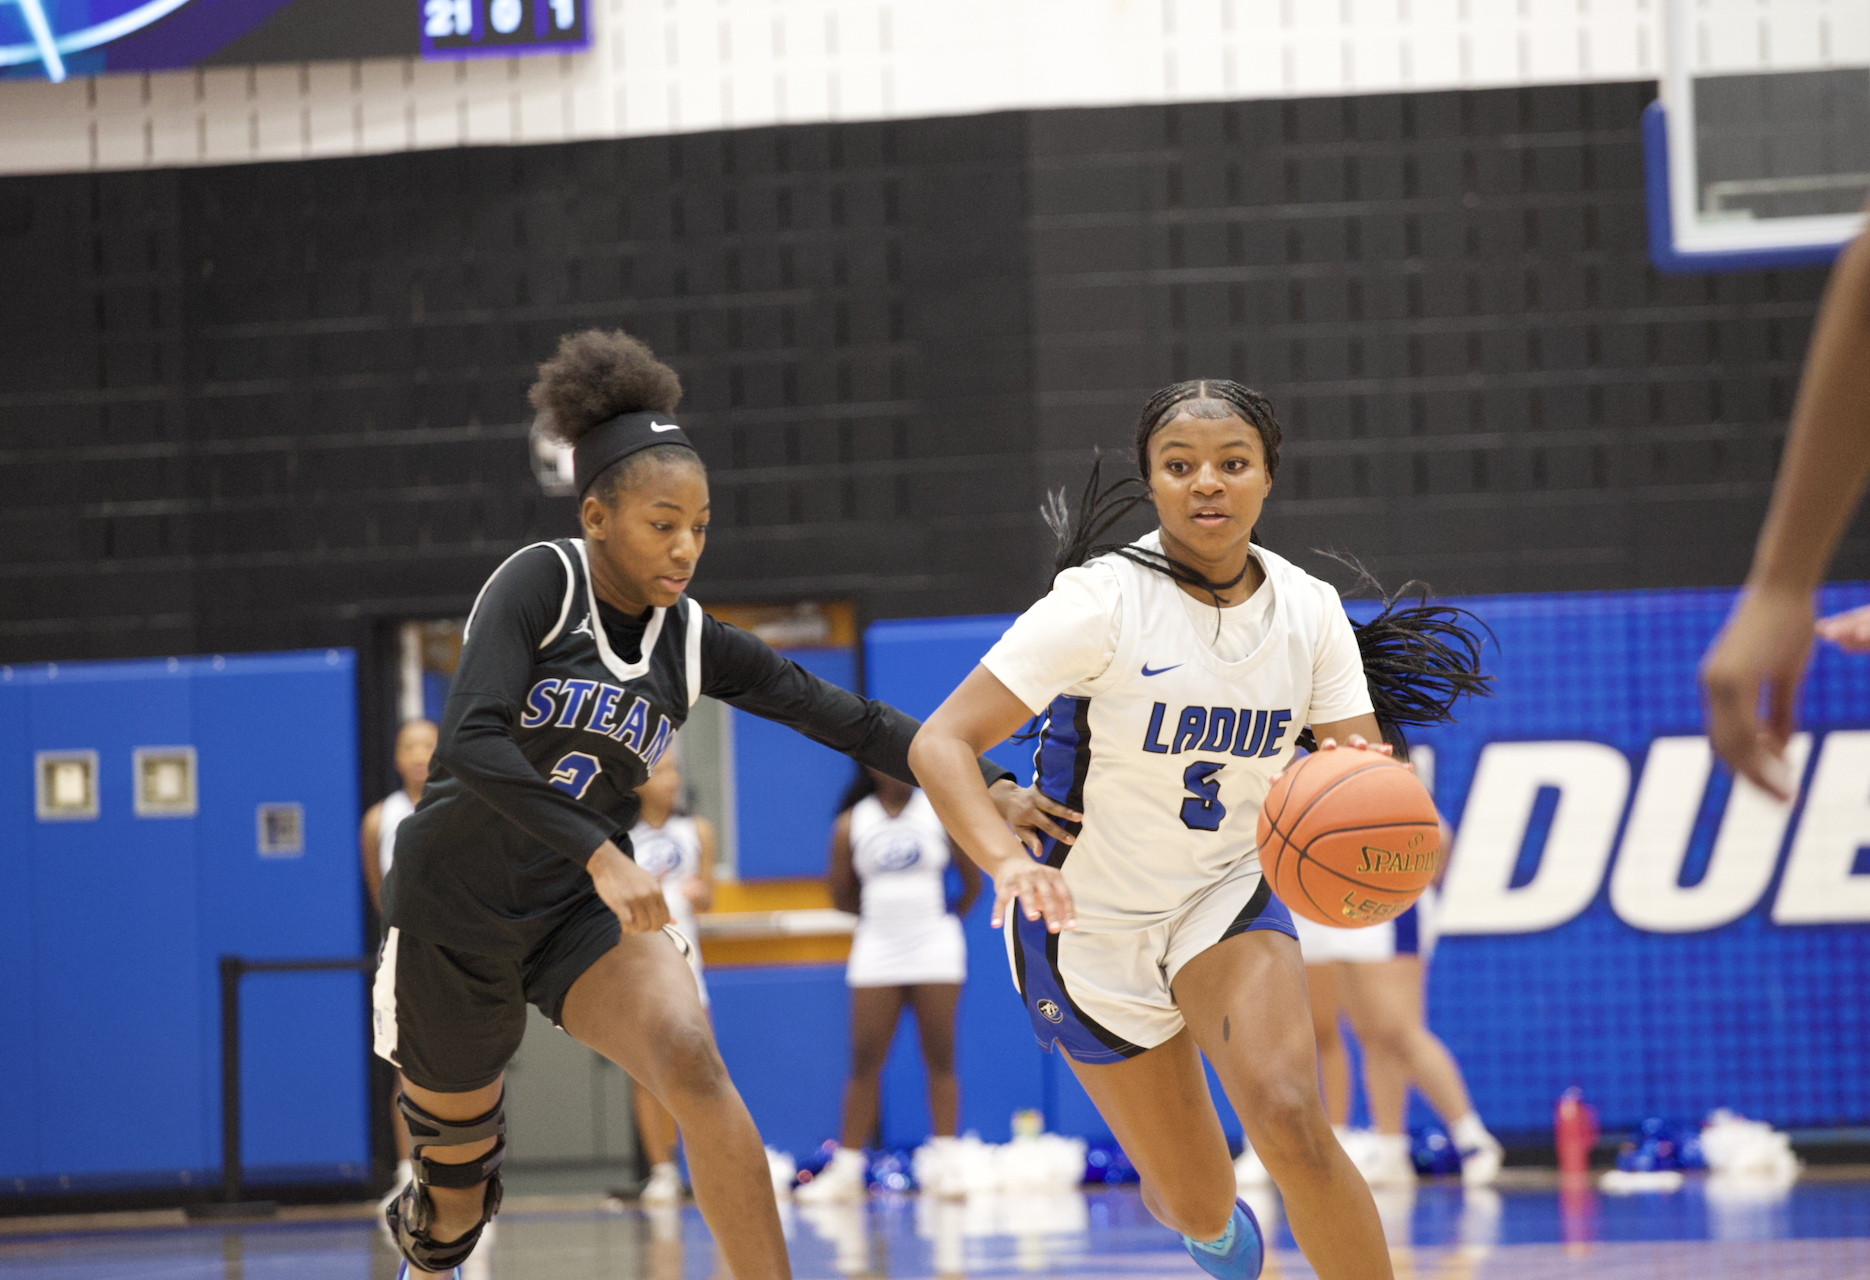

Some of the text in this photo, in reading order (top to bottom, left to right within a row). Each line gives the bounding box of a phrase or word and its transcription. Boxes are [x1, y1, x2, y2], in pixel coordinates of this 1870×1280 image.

[424, 0, 473, 37] 21
[1142, 701, 1292, 759] LADUE
[1179, 760, 1226, 832] 5
[1357, 846, 1439, 873] SPALDIN
[1412, 730, 1870, 935] DUE
